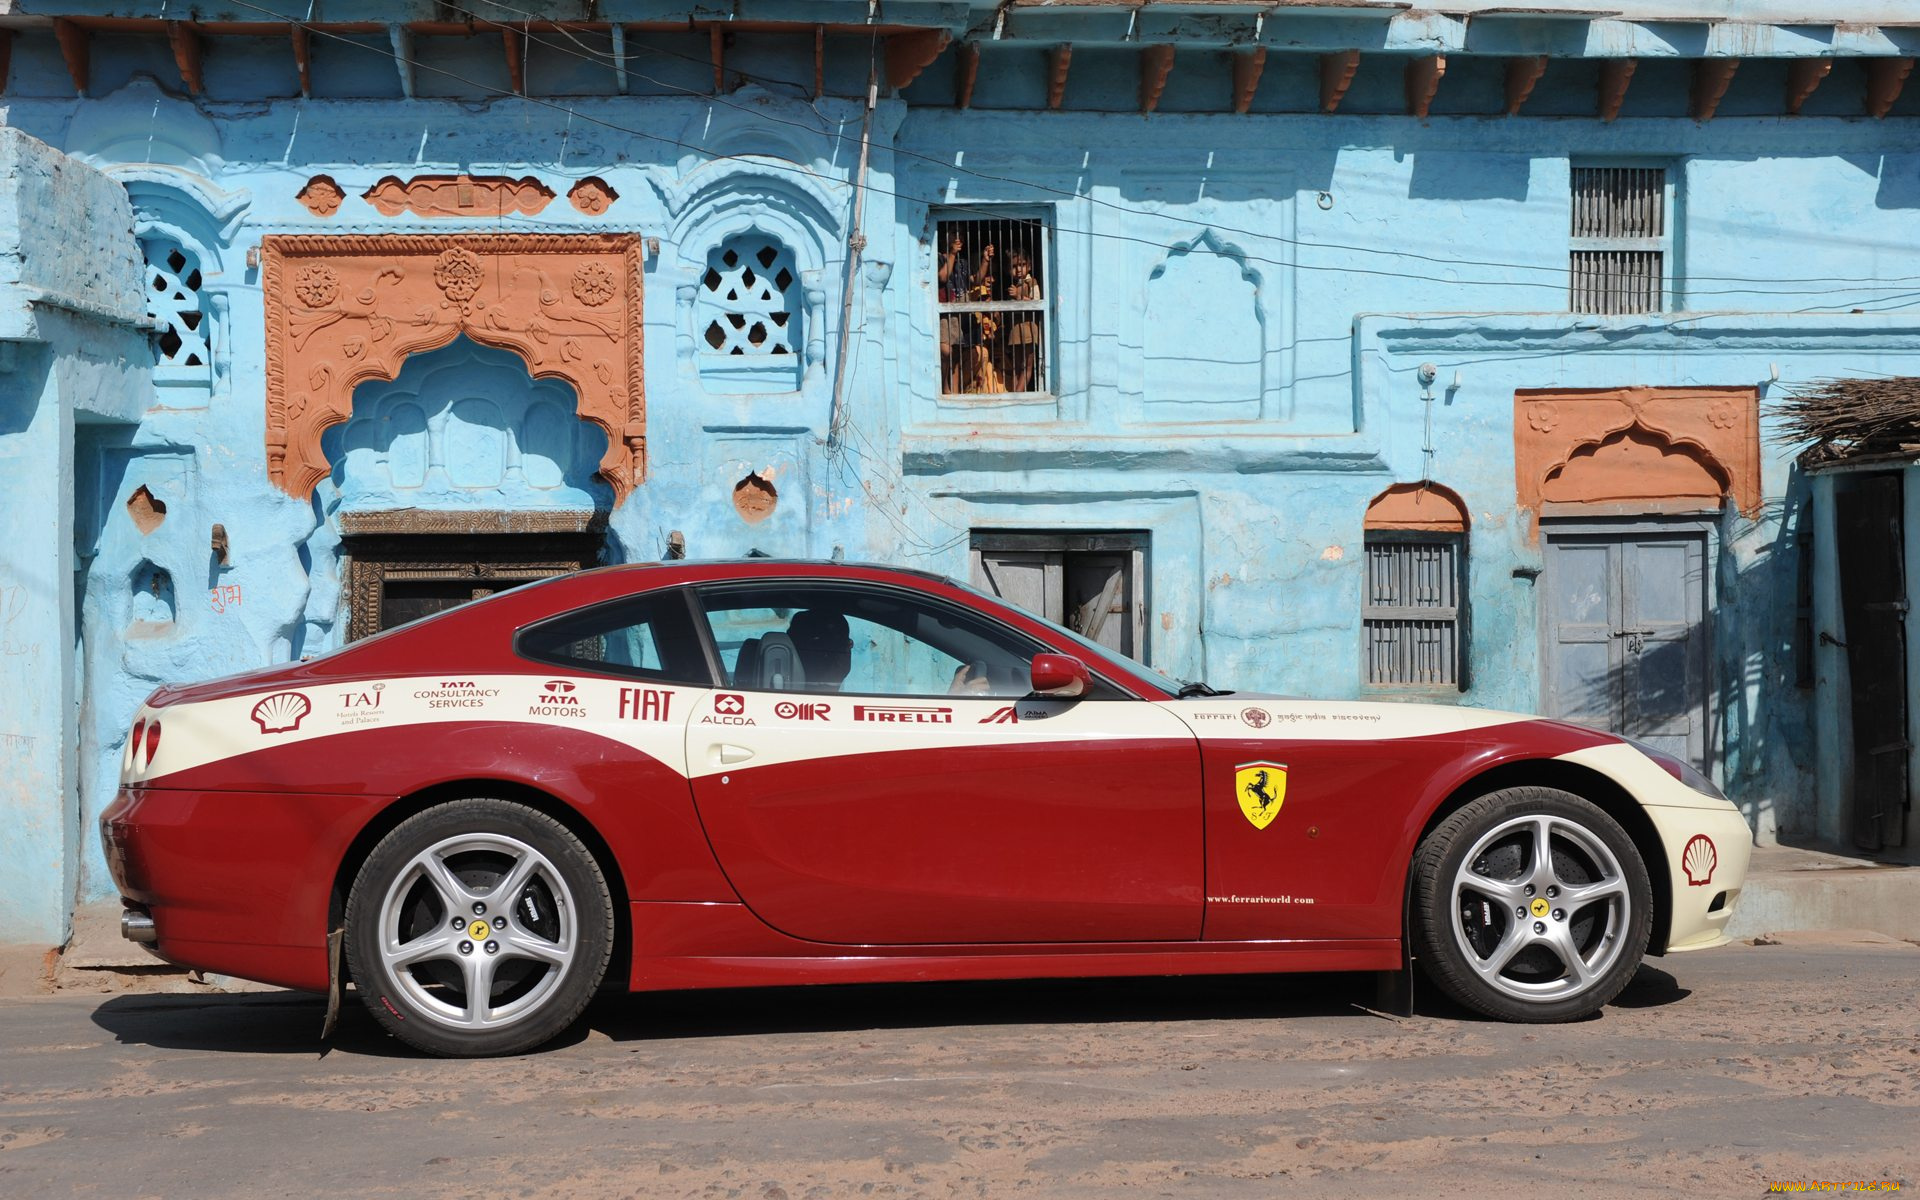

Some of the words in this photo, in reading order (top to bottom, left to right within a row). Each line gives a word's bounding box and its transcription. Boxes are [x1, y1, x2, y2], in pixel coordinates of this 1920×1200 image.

[413, 689, 500, 698] CONSULTANCY
[428, 699, 484, 708] SERVICES
[539, 695, 579, 705] TATA
[618, 687, 675, 722] FIAT
[528, 706, 587, 718] MOTORS
[853, 705, 953, 724] PIRELLI
[701, 715, 757, 727] ALCOA
